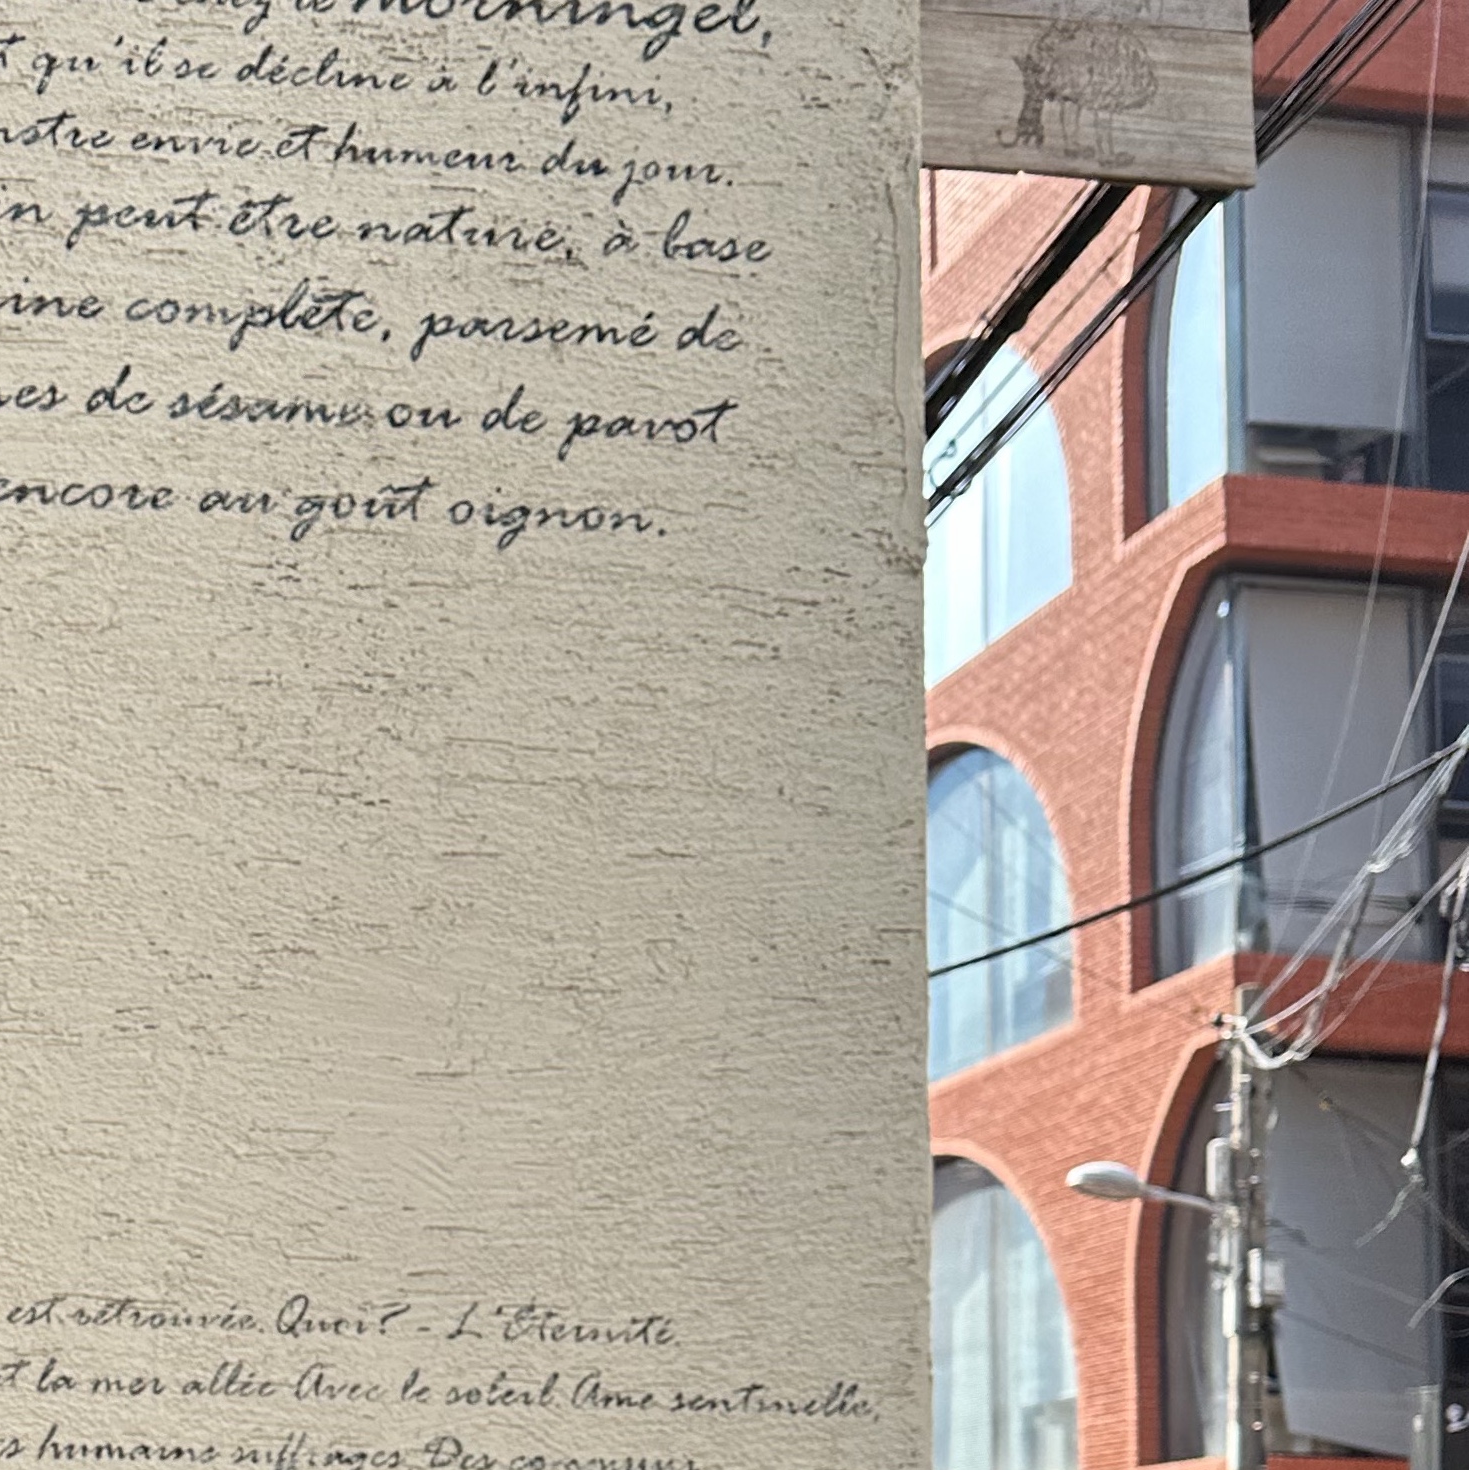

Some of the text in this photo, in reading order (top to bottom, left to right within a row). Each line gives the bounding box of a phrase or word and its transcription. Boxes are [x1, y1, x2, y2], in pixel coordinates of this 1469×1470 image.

[32, 36, 168, 95] qu'il
[175, 60, 217, 80] se
[236, 44, 412, 90] décline
[478, 62, 673, 124] l'infini,
[131, 132, 263, 159] envie
[276, 124, 327, 162] et
[333, 122, 526, 176] humeur
[540, 140, 608, 176] du
[612, 160, 734, 206] jour.
[66, 190, 211, 249] peut
[229, 193, 339, 241] être
[603, 219, 637, 256] à
[663, 209, 773, 263] base
[410, 311, 660, 362] parsemé
[676, 304, 744, 351] de
[85, 365, 156, 414] de
[170, 383, 364, 424] sésame
[387, 405, 464, 429] ou
[480, 385, 546, 433] de
[560, 399, 738, 461] pavot
[198, 493, 272, 514] au
[290, 476, 442, 543] goût
[448, 487, 667, 550] oignon.
[6, 1296, 66, 1326] est
[36, 1357, 78, 1394] la
[92, 1376, 163, 1396] mer
[294, 1362, 386, 1401] Avec
[400, 1368, 433, 1400] le
[444, 1371, 558, 1409] soleil
[36, 1423, 220, 1462] humains
